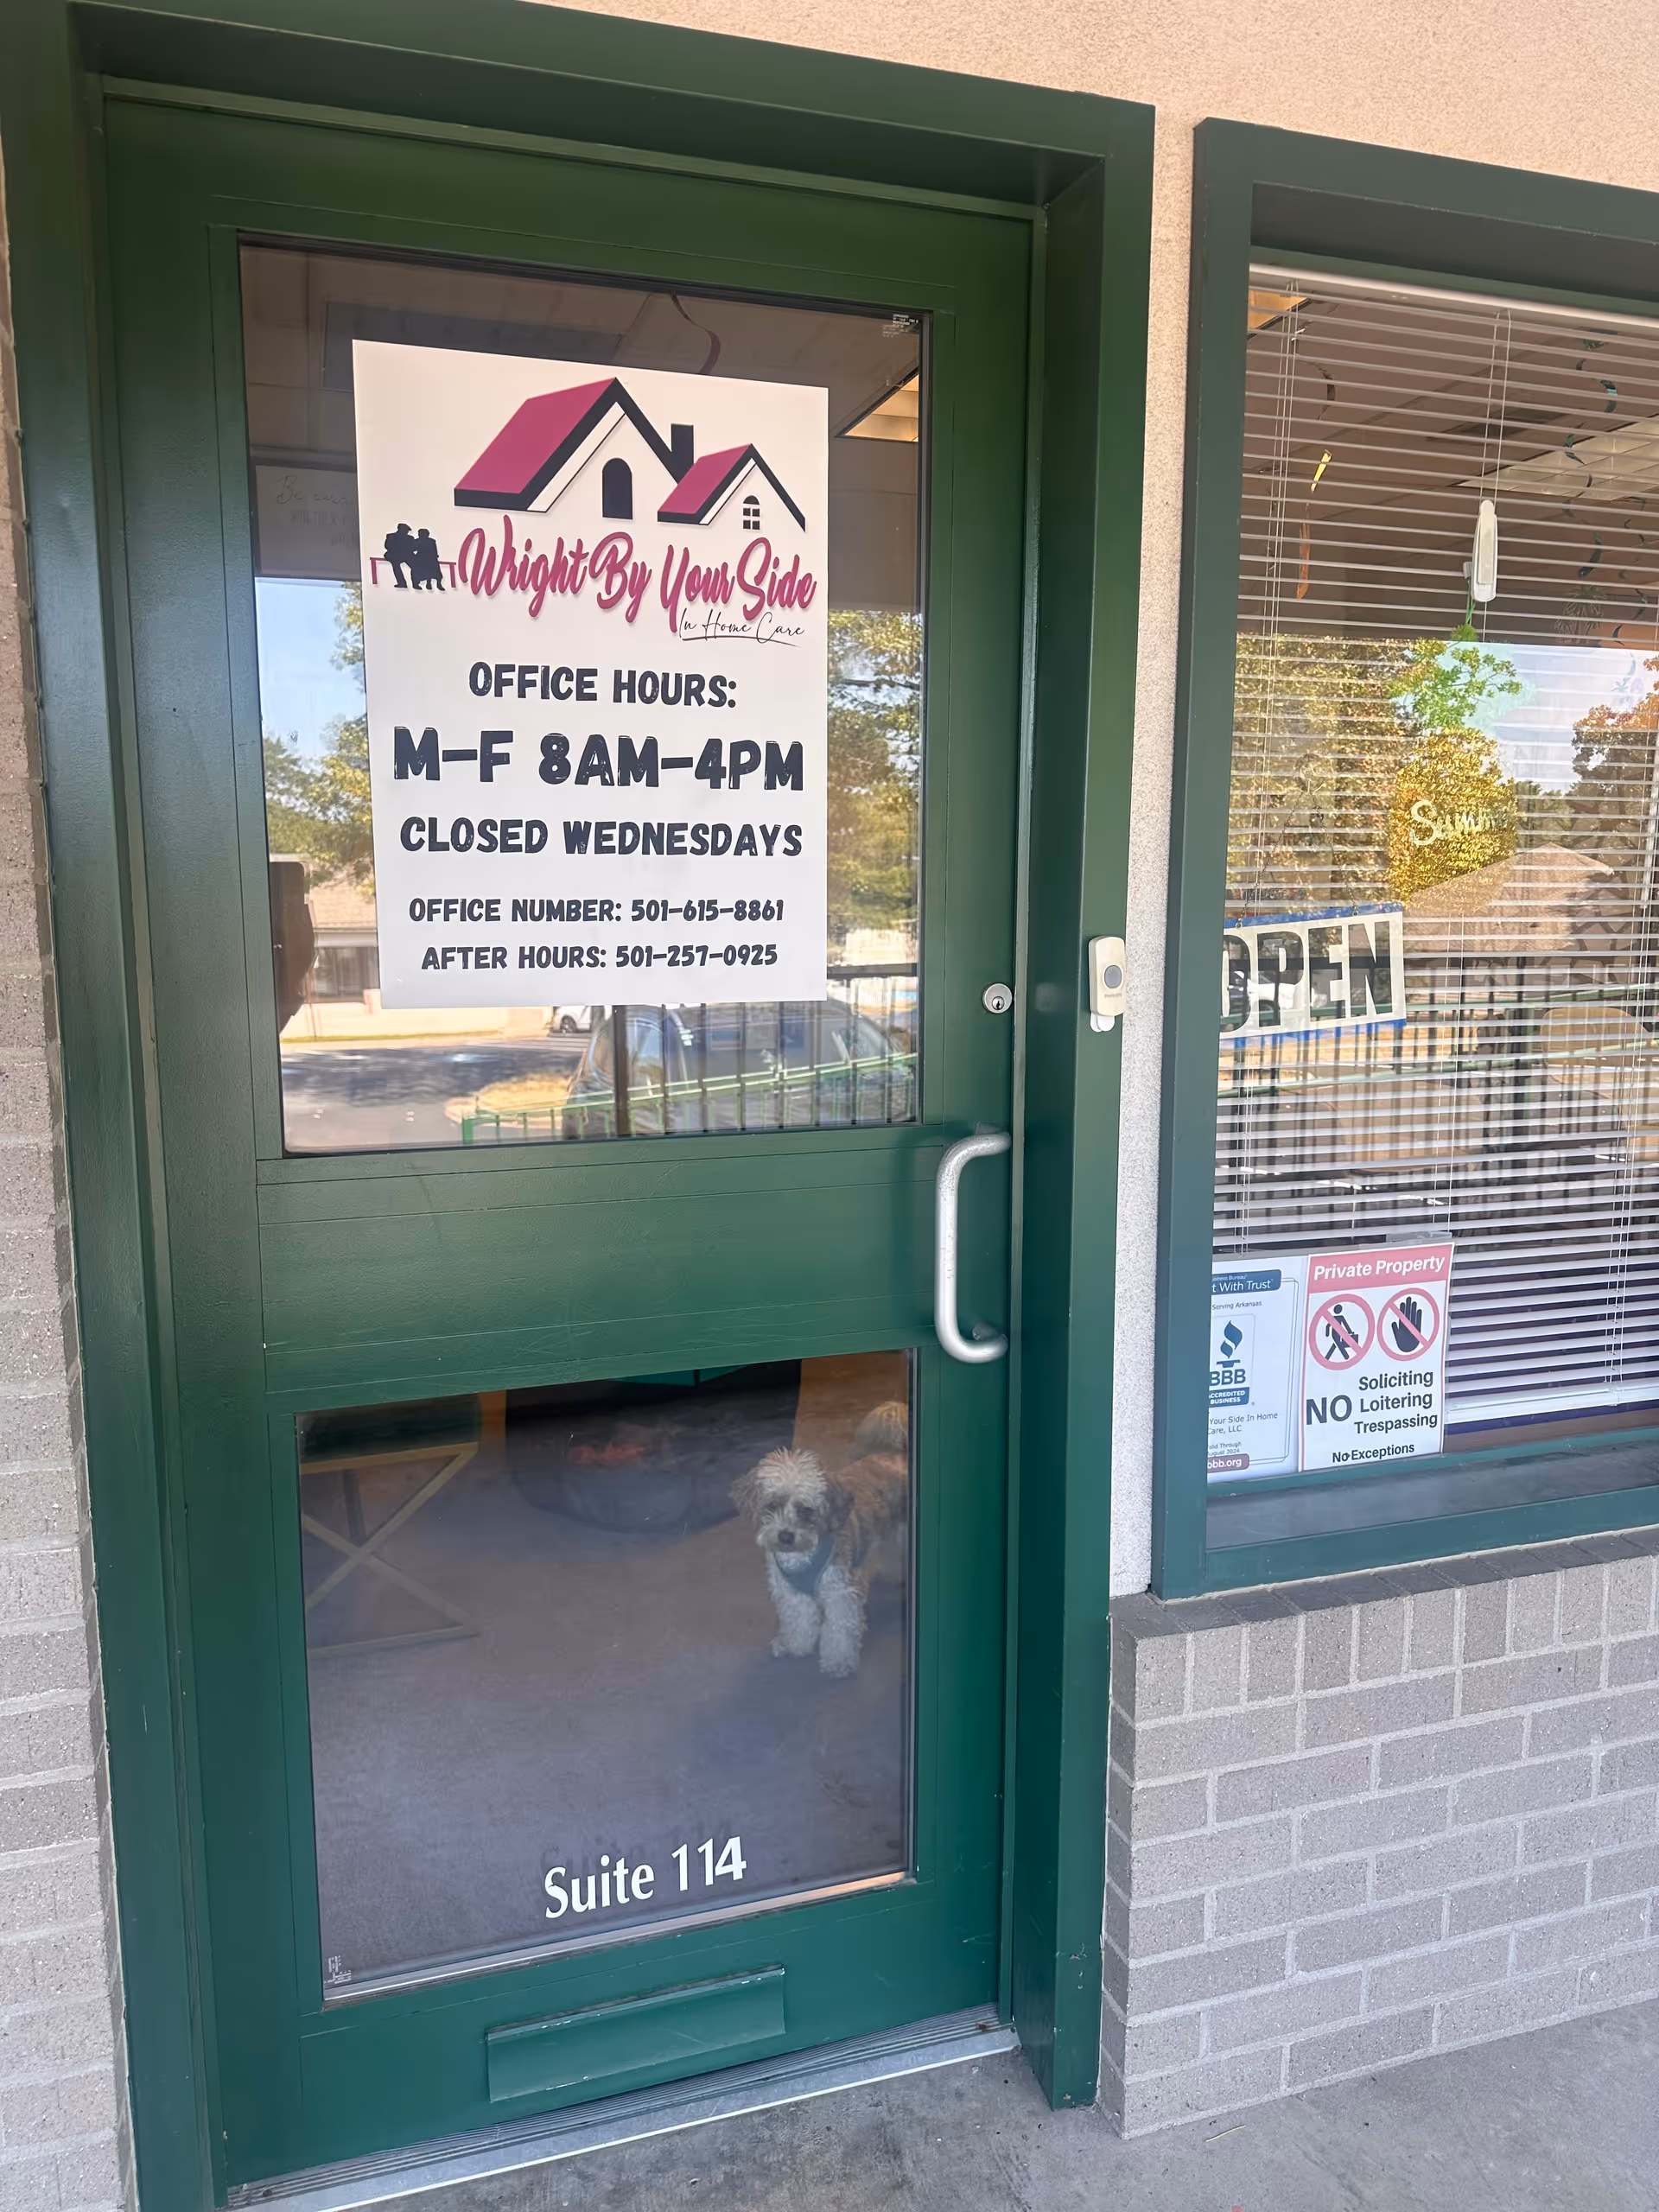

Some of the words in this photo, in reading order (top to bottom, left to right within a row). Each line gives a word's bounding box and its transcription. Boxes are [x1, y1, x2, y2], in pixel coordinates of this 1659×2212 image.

[459, 515, 589, 618] Wright
[588, 531, 652, 623] By
[660, 544, 734, 632] Your
[736, 537, 817, 621] Side
[679, 607, 697, 639] In
[702, 609, 752, 640] Home
[756, 612, 804, 643] Care
[469, 662, 597, 701] OFFICE
[613, 670, 737, 708] HOURS:
[394, 727, 513, 782] M-F
[539, 733, 804, 791] 8AM-4PM
[400, 817, 548, 854] CLOSED
[563, 821, 802, 856] WEDNESDAYS
[409, 899, 501, 922] OFFICE
[512, 899, 621, 922] NUMBER:
[632, 899, 784, 922] 501-615-8861
[422, 947, 507, 969] AFTER
[519, 946, 607, 969] HOURS:
[616, 944, 778, 967] 501-257-0925
[1219, 920, 1393, 1033] OPEN
[1313, 1262, 1372, 1281] Private
[1376, 1255, 1446, 1276] Property
[1219, 1281, 1243, 1293] With
[1246, 1279, 1272, 1290] Trust
[1210, 1369, 1246, 1386] BBB
[1358, 1370, 1433, 1391] Soliciting
[1306, 1394, 1352, 1426] NO
[1360, 1392, 1433, 1413] Loitering
[1354, 1414, 1438, 1434] Trespassing
[1332, 1452, 1351, 1463] No
[1351, 1444, 1414, 1460] Exceptions
[545, 1855, 655, 1918] Suite
[671, 1836, 747, 1891] 114
